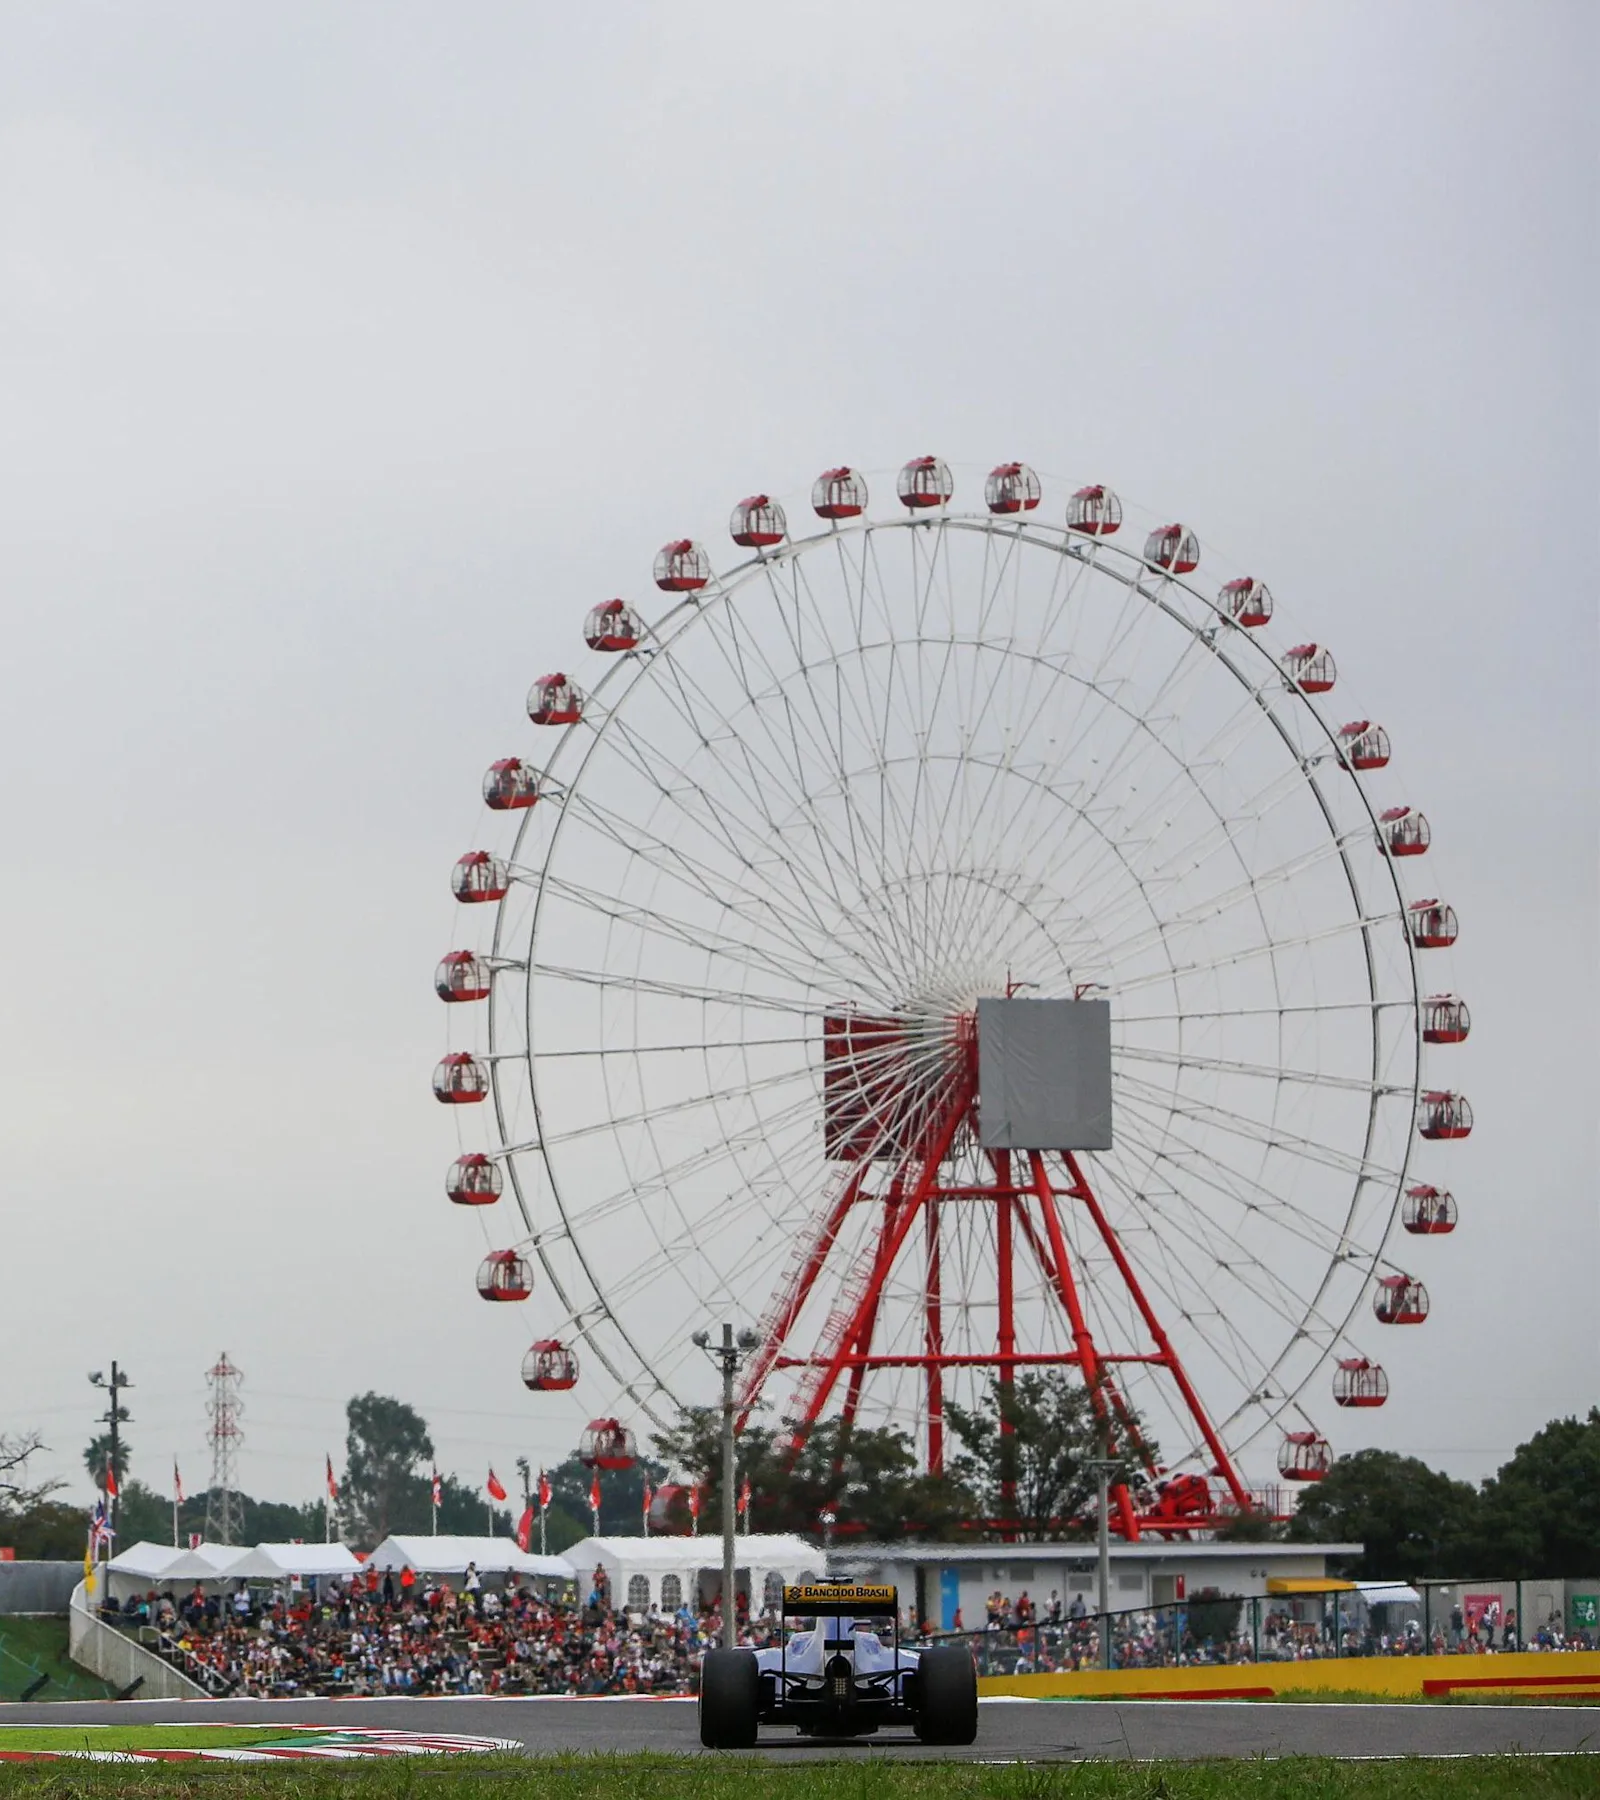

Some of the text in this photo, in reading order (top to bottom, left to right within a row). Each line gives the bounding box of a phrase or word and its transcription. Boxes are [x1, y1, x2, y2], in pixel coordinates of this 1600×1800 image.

[805, 1586, 889, 1597] BANCO DO BRASIL
